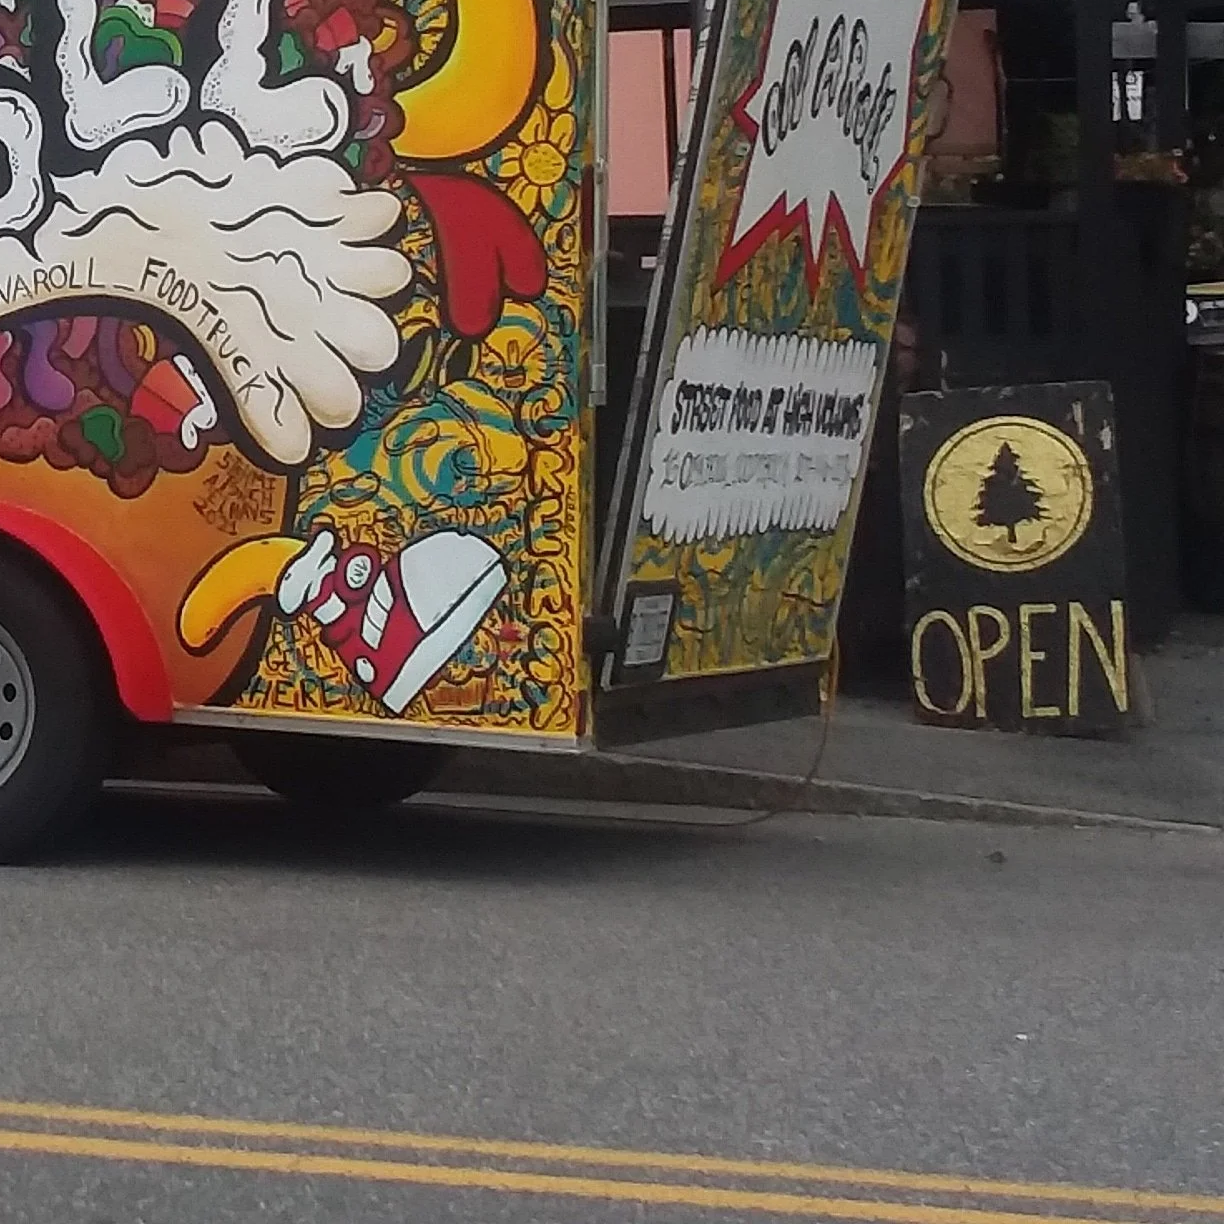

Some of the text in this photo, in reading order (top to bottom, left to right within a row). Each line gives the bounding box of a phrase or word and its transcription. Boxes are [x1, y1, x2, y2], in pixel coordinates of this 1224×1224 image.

[671, 379, 733, 435] STREET
[727, 380, 763, 434] FOOD
[760, 387, 786, 436] AT
[912, 599, 1128, 718] OPEN
